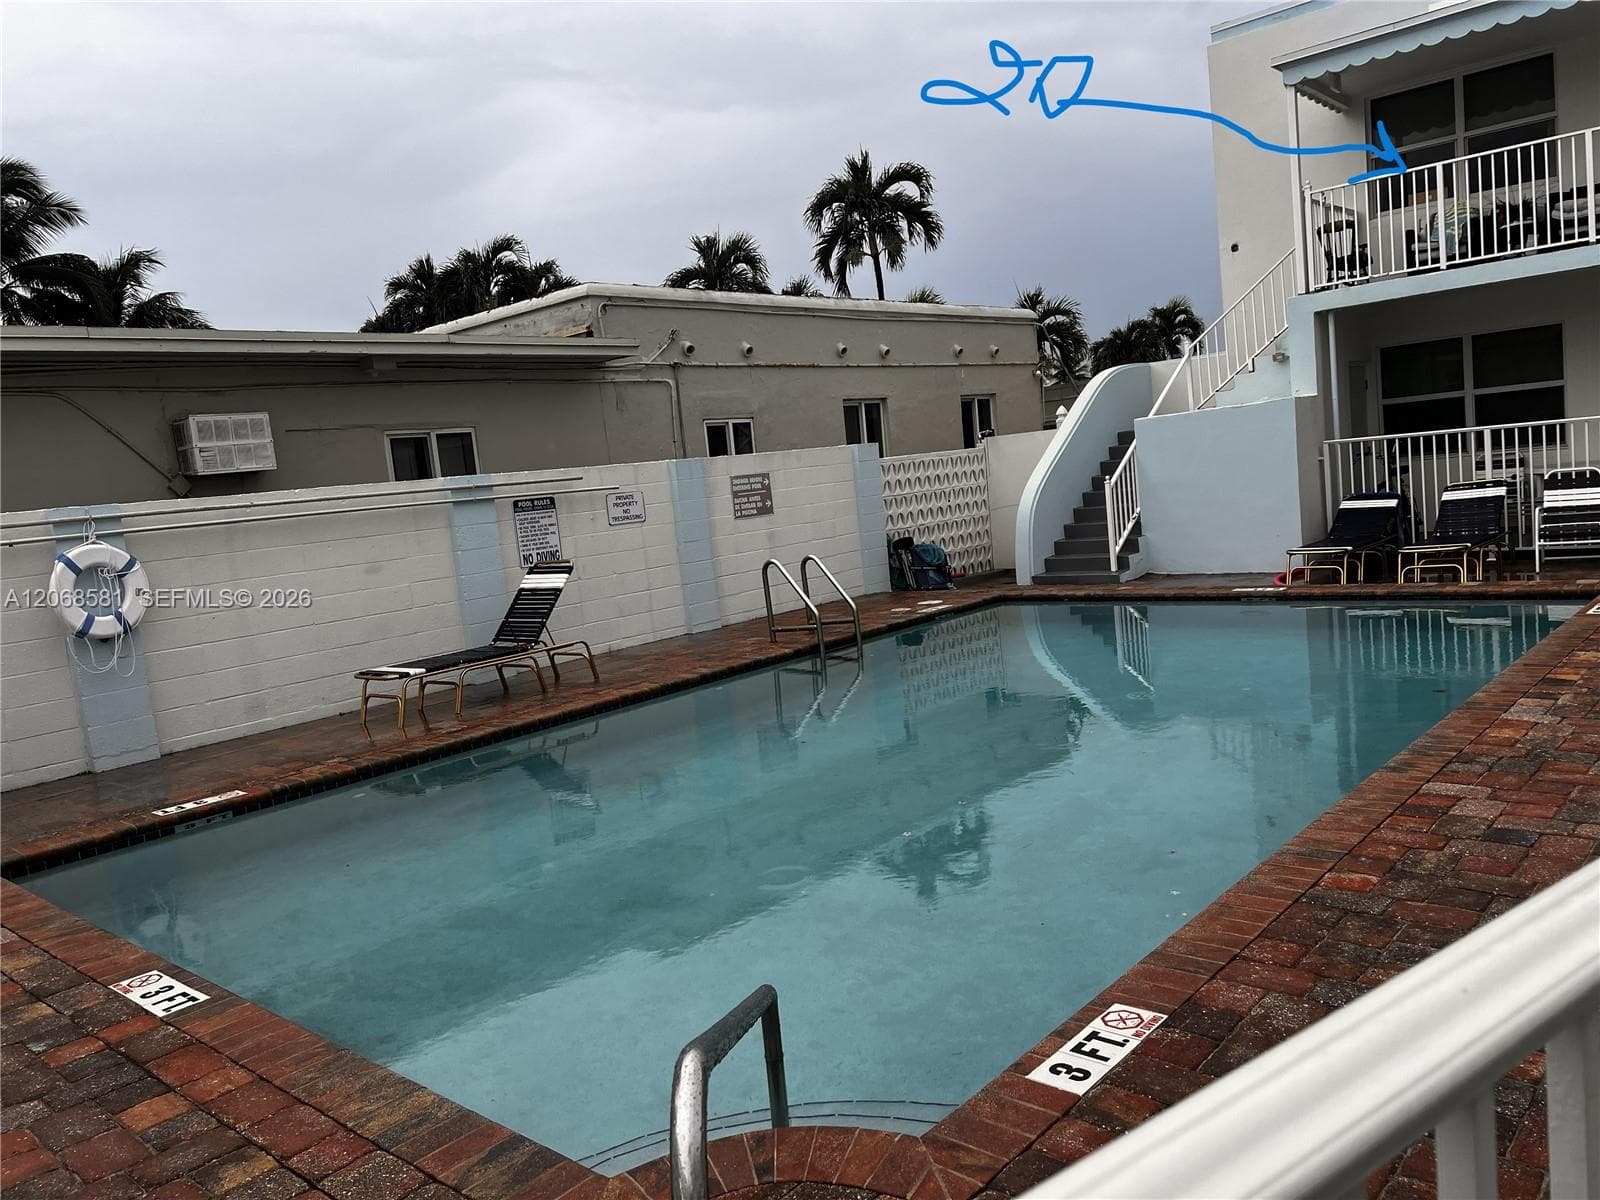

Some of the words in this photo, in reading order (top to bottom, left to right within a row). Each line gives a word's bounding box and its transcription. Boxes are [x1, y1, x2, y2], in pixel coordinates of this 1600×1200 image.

[518, 500, 533, 508] POOL
[612, 500, 638, 508] PROPERTY
[611, 513, 644, 522] TRESPASSING
[522, 553, 534, 567] NO
[536, 549, 560, 561] DIVING
[140, 985, 175, 999] 3
[1048, 1062, 1092, 1082] 3
